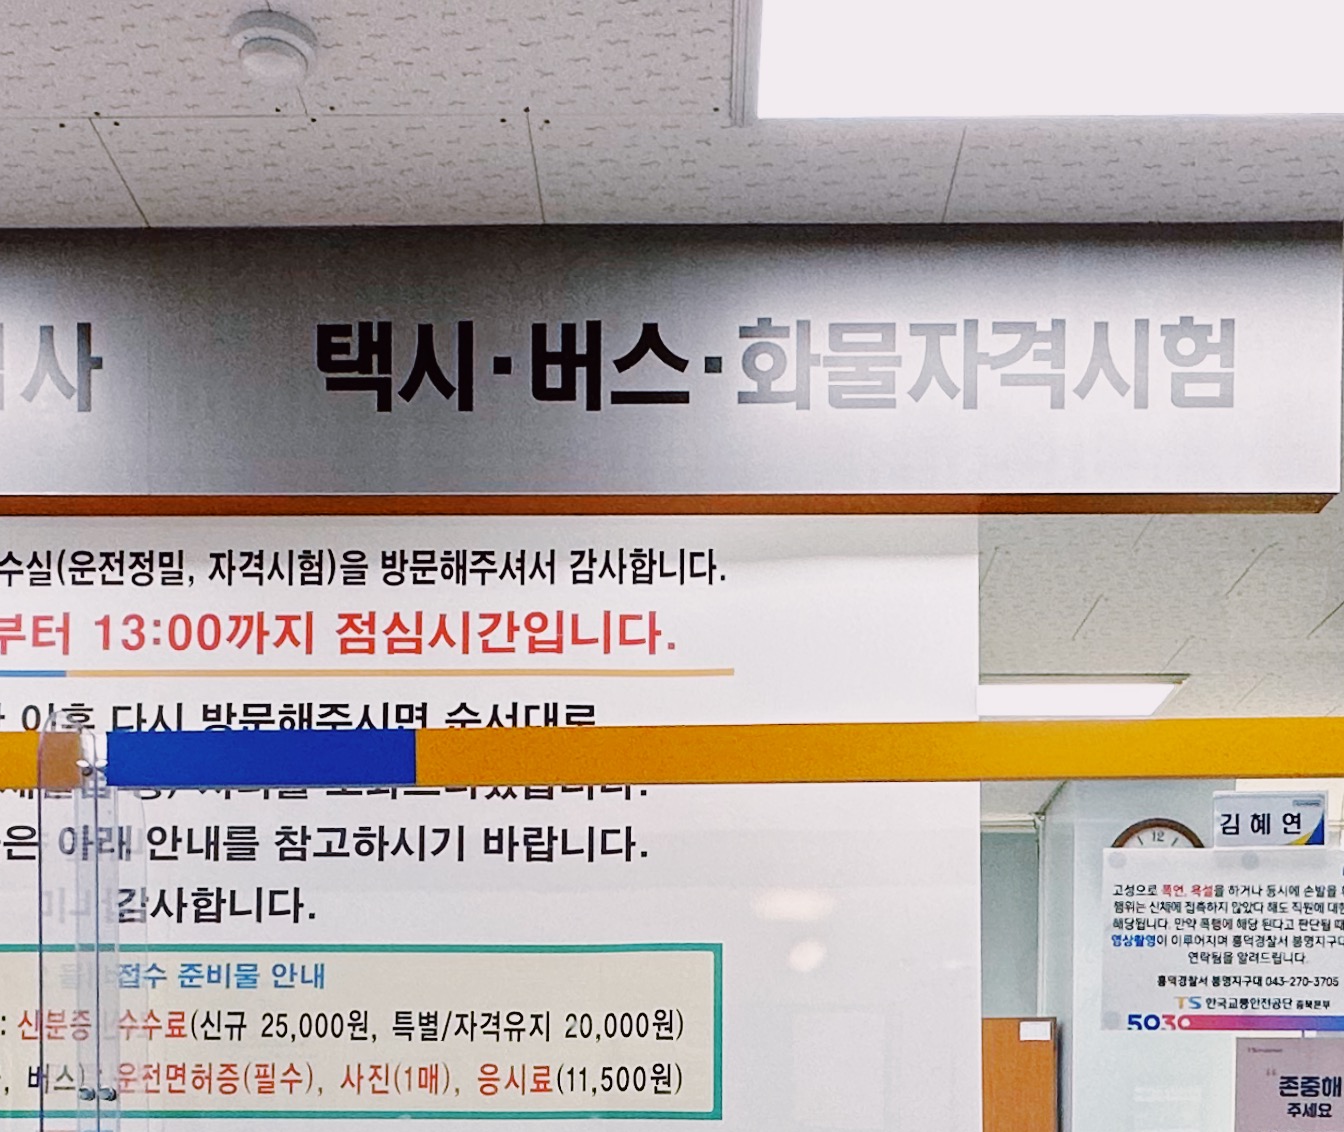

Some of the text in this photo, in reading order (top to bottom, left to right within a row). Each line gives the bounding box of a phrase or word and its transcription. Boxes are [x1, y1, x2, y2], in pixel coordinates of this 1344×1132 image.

[208, 548, 370, 588] 자격시험)을
[381, 548, 557, 588] 방문해주셔서
[570, 547, 727, 587] 감사합니다.
[94, 610, 314, 656] 13:00까지
[336, 610, 676, 656] 점심시간입니다.
[112, 702, 183, 732] 다시
[1220, 812, 1301, 835] 김혜연
[57, 824, 132, 863] 아래
[146, 824, 262, 863] 안내를
[273, 824, 467, 863] 참고하시기
[482, 824, 652, 863] 바랍니다.
[1151, 830, 1165, 843] 12
[1113, 884, 1157, 897] 고성으로
[1228, 884, 1262, 897] 하거나
[1266, 884, 1300, 897] 동시에
[1303, 884, 1337, 897] 손발을
[117, 886, 318, 925] 감사합니다.
[1114, 901, 1145, 914] 행위는
[1267, 901, 1289, 914] 해도
[1292, 901, 1325, 914] 직원에
[1174, 918, 1196, 931] 만약
[1236, 918, 1258, 931] 해당
[1261, 918, 1294, 931] 된다고
[1171, 934, 1228, 947] 이루어지며
[119, 963, 325, 989] 접수 준비물 안내
[1265, 975, 1339, 987] 043-270-3705
[1174, 996, 1202, 1010] TS
[1206, 998, 1292, 1010] 한국교통안전공단
[117, 1009, 247, 1042] 수수료(신규
[261, 1010, 377, 1043] 25,000원,
[392, 1010, 551, 1042] 특별/자격유지
[565, 1008, 685, 1041] 20,000원)
[117, 1063, 324, 1097] 운전면허증(필수),
[341, 1063, 460, 1097] 사진(1매),
[477, 1063, 684, 1097] 응시료(11,500원)
[1278, 1075, 1343, 1098] 존중해
[1286, 1102, 1333, 1118] 주세요
